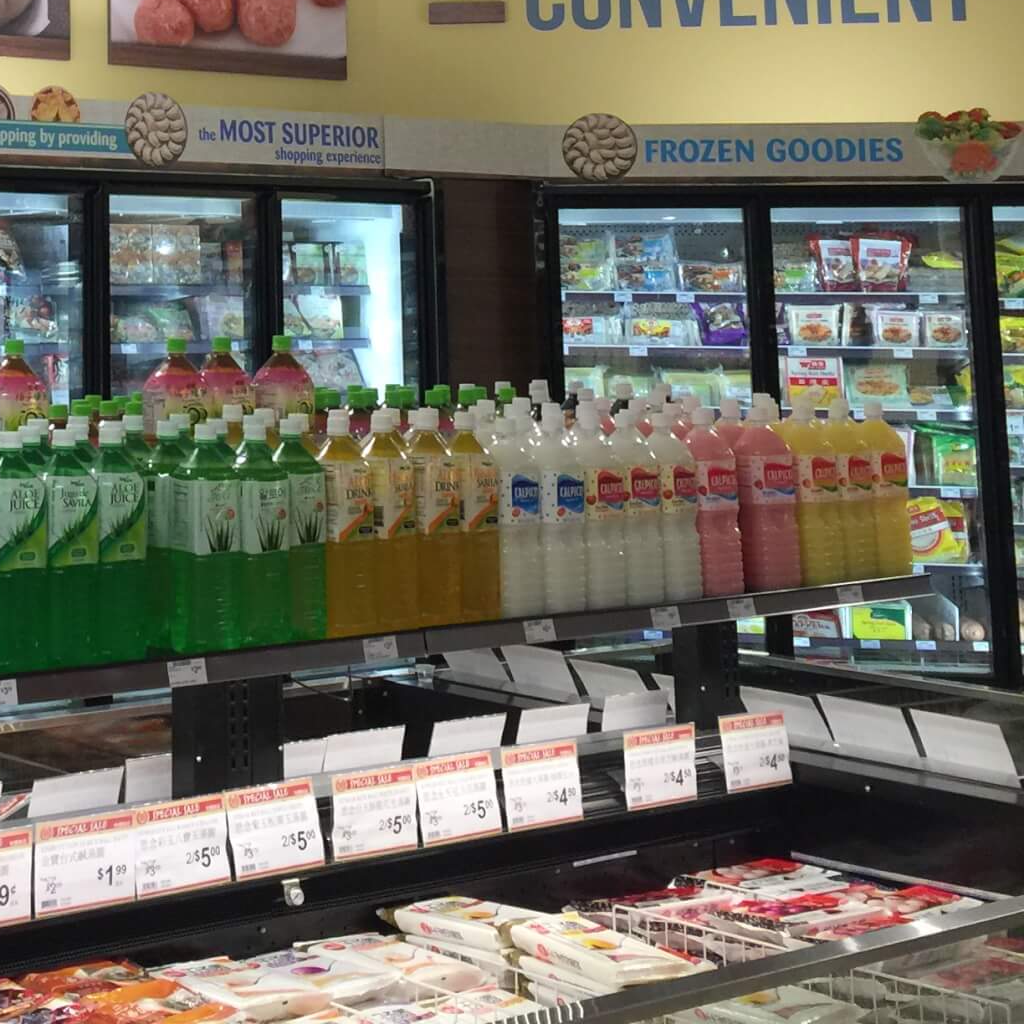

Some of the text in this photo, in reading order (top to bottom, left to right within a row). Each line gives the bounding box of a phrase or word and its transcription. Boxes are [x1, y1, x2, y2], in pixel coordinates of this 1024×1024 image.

[40, 127, 56, 147] by
[58, 130, 118, 151] providing
[198, 118, 380, 149] the MOST SUPERIOR
[274, 147, 382, 165] shopping experience
[644, 137, 904, 164] FROZEN GOODIES
[9, 498, 41, 513] JUICE
[110, 492, 139, 505] JUICE
